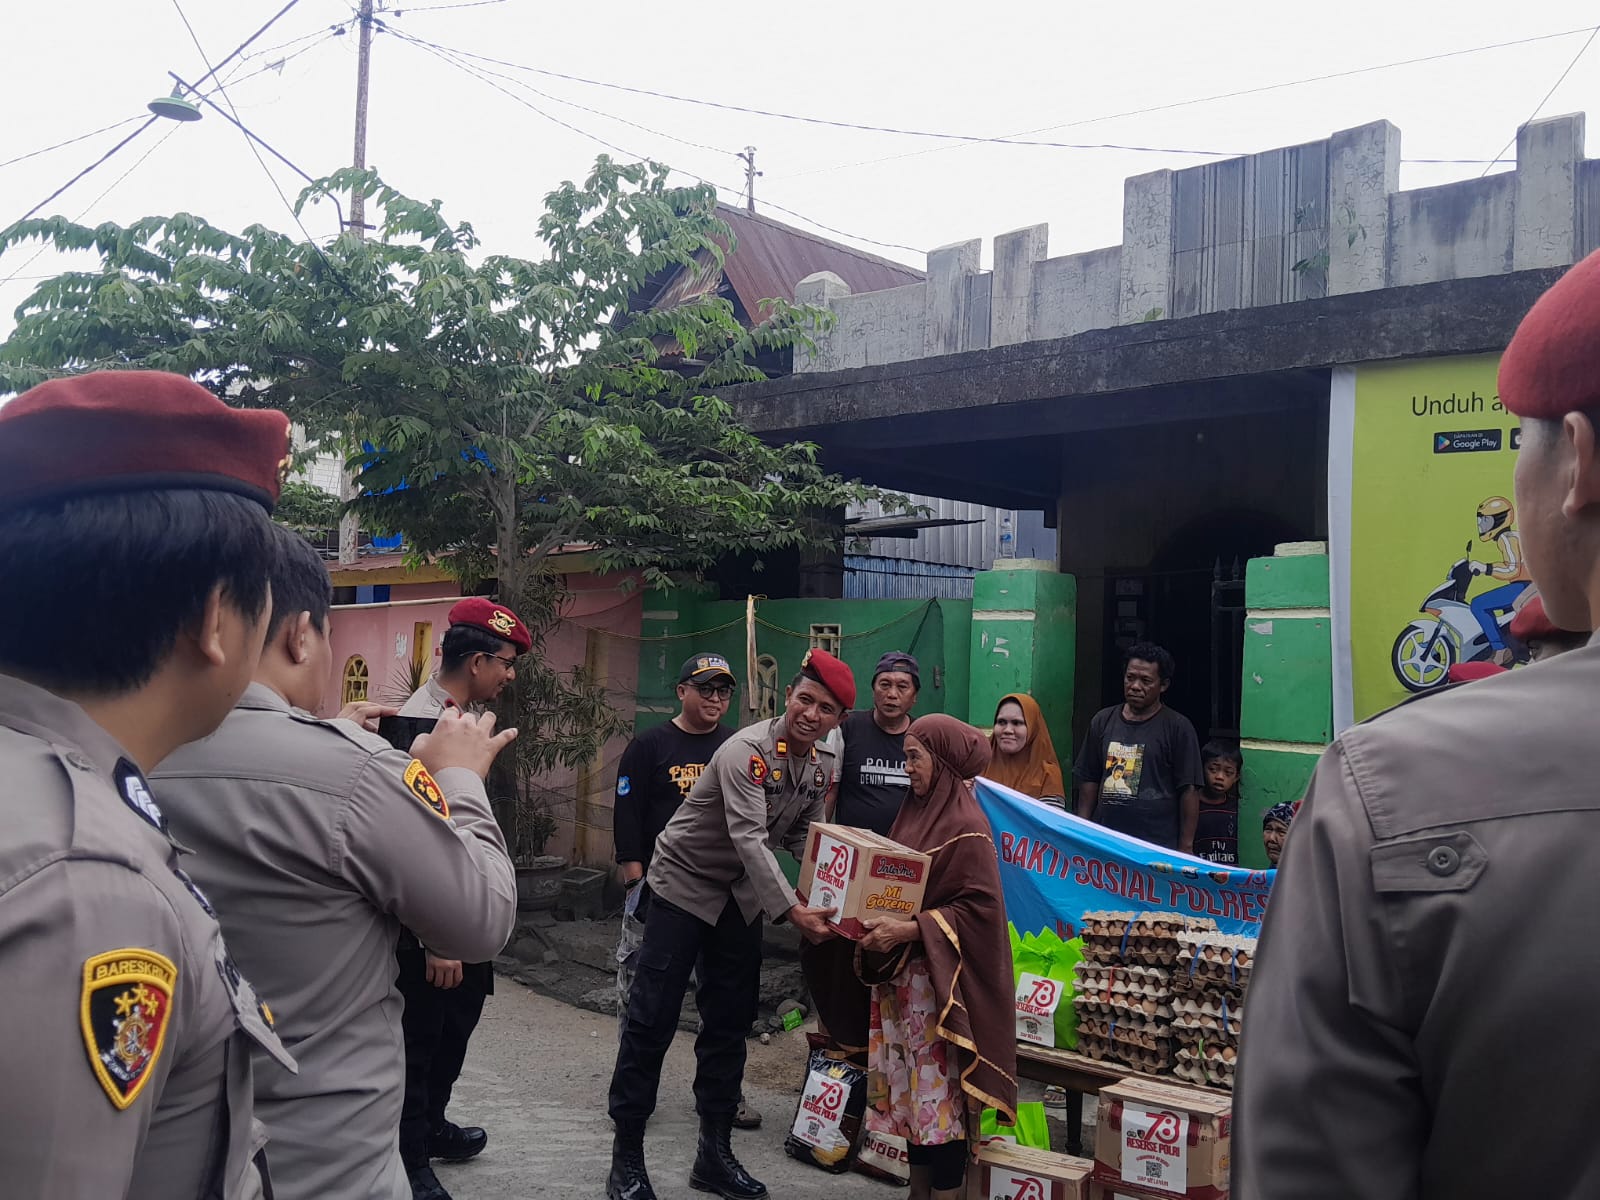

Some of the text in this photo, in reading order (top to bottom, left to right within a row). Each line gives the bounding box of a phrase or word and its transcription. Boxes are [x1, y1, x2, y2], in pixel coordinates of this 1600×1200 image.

[1412, 391, 1508, 416] Unduh a
[1453, 438, 1497, 449] Google Play
[860, 774, 884, 785] DENIM
[1212, 840, 1226, 851] Fly
[1000, 831, 1071, 879] BAKTI
[1072, 855, 1161, 904] SOSIAL
[882, 885, 902, 899] Mi
[866, 894, 915, 914] Goreng
[96, 957, 169, 981] BARESKRIM
[1126, 1137, 1181, 1157] RESERSE POLRI
